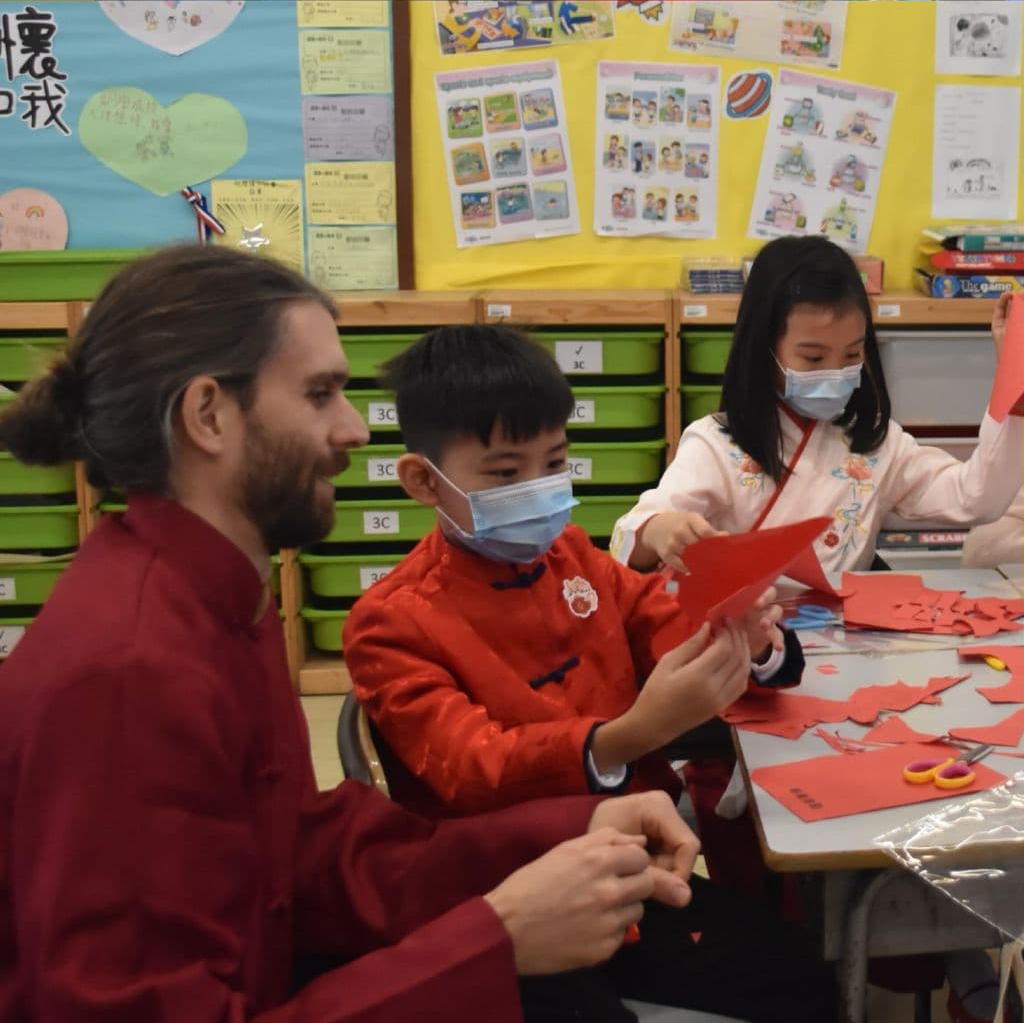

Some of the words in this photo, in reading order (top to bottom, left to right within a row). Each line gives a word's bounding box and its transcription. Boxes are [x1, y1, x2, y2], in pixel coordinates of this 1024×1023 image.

[573, 360, 585, 370] 3C
[376, 408, 396, 421] 3C
[376, 464, 396, 477] 3C
[372, 517, 391, 529] 3C
